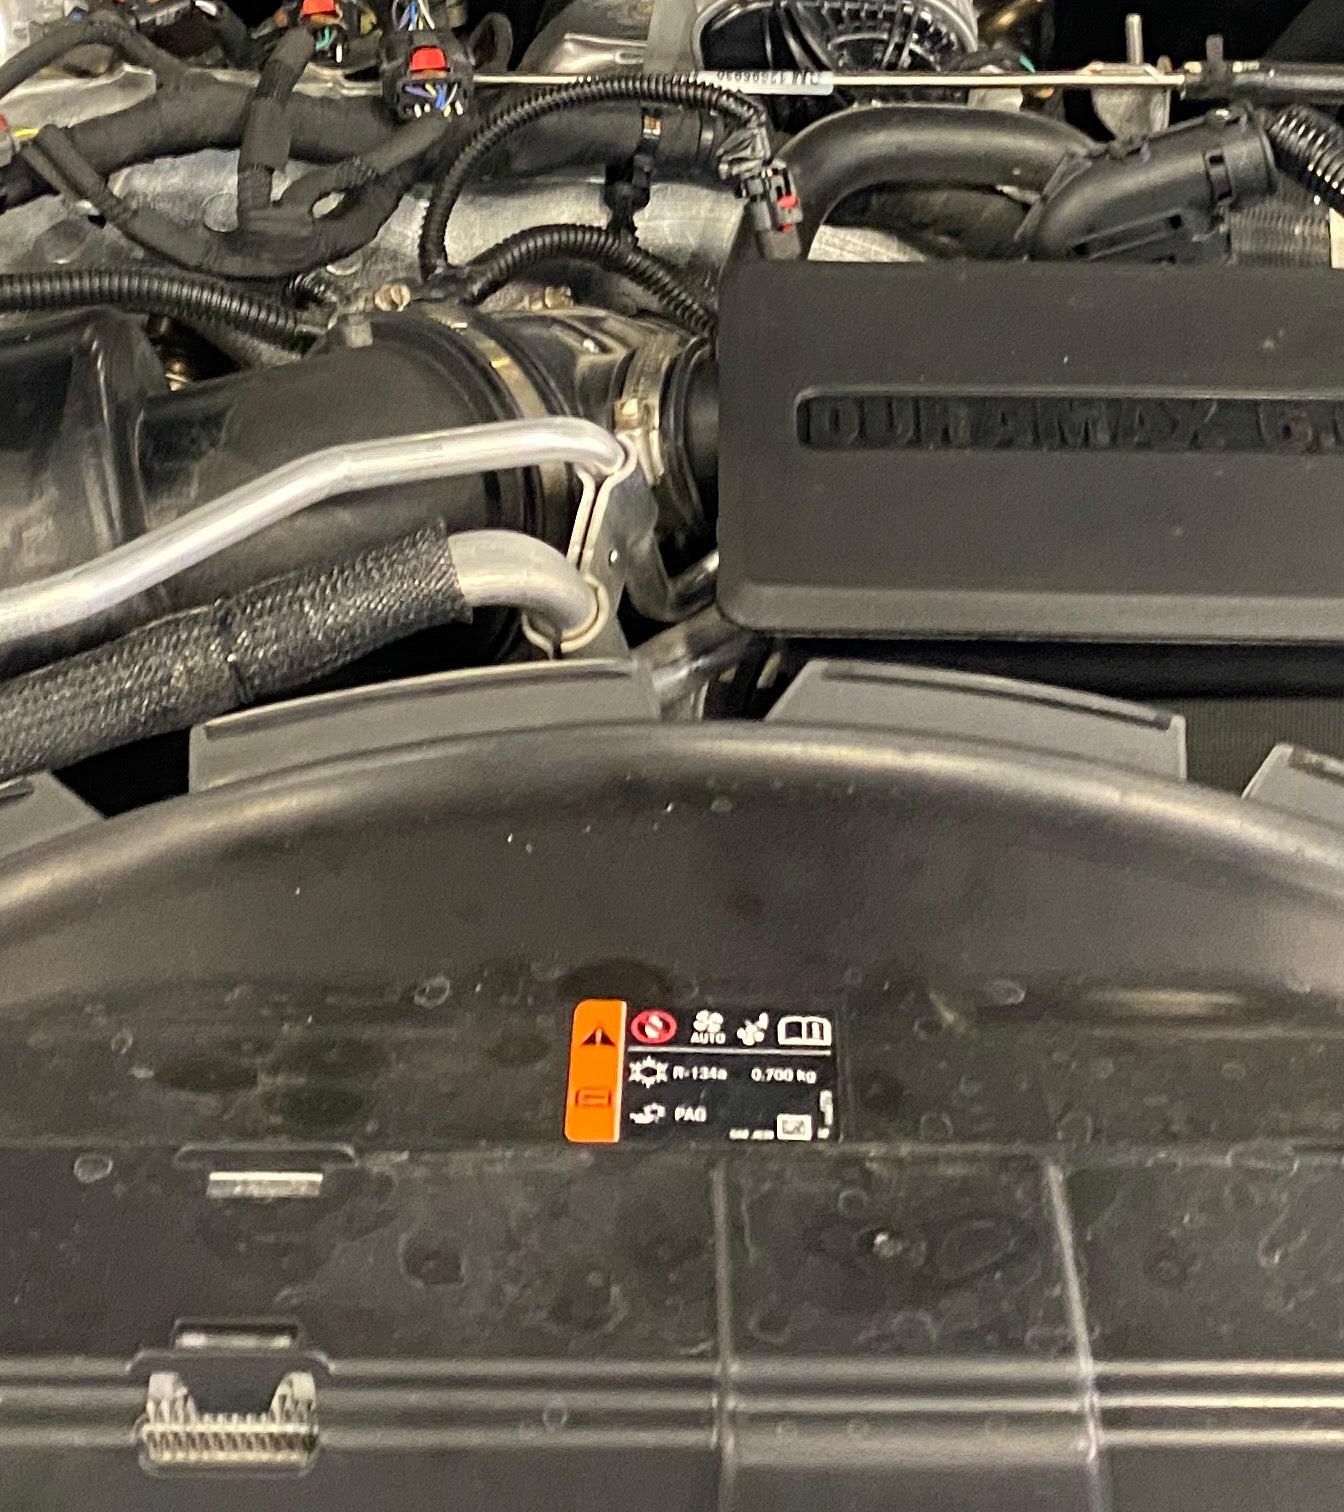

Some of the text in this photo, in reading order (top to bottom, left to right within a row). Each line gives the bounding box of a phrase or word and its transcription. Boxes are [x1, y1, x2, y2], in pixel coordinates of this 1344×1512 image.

[808, 397, 1220, 450] DURAMAX
[691, 1032, 726, 1045] AUTO
[673, 1066, 817, 1084] R-134a 0.700 kg
